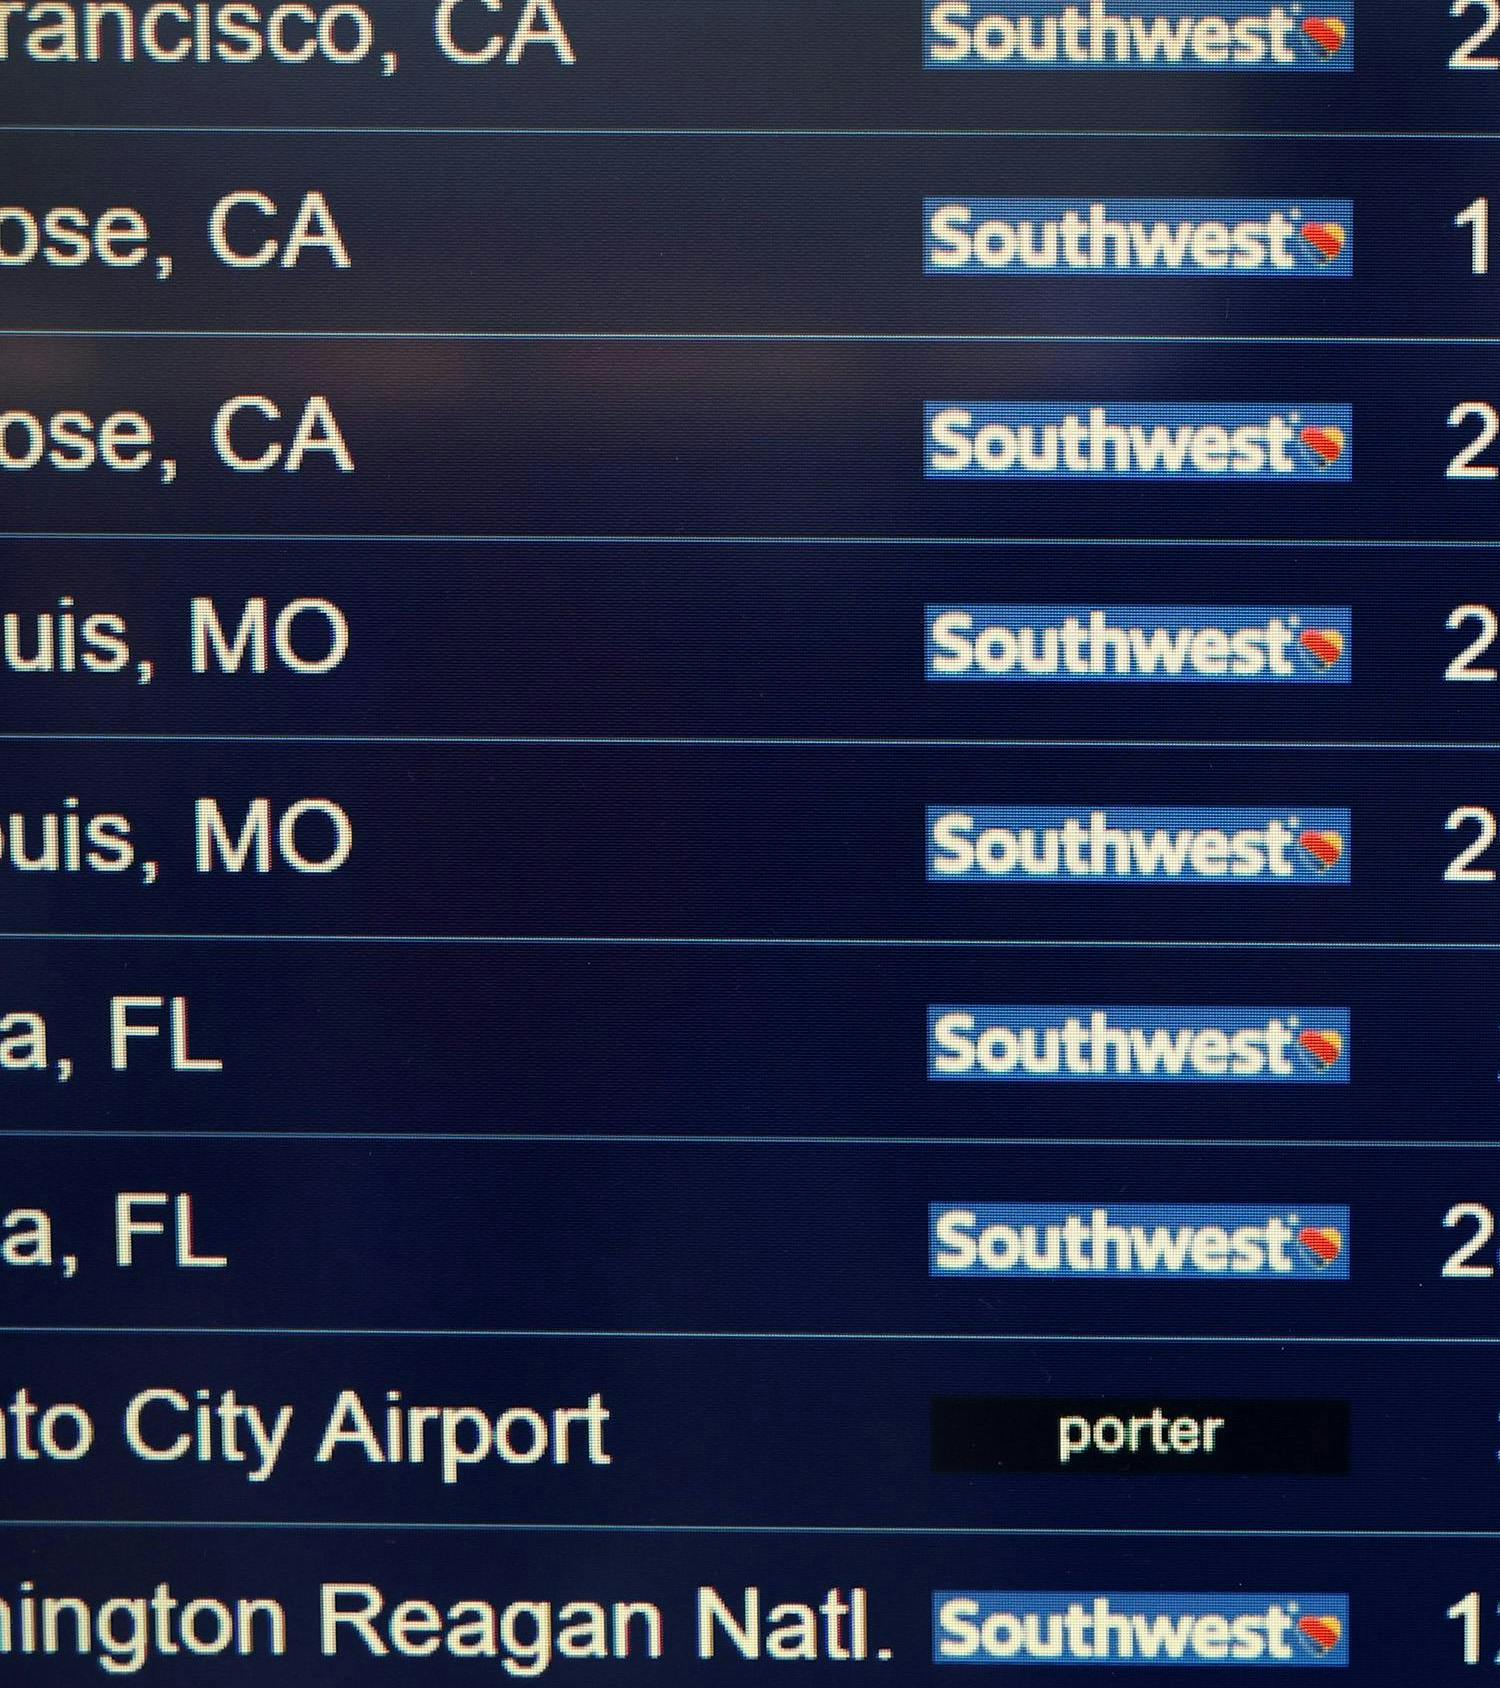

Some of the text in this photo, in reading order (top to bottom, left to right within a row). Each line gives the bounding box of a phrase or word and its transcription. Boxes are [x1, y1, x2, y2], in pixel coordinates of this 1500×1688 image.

[435, 0, 576, 64] CA
[930, 0, 1295, 63] Southwest
[210, 190, 351, 268] CA
[930, 202, 1297, 269] Southwest
[214, 394, 355, 471] CA
[930, 407, 1297, 473] Southwest
[193, 597, 349, 673] MO
[932, 610, 1297, 675] Southwest
[0, 797, 157, 883] uis,
[197, 798, 353, 873] MO
[933, 811, 1297, 876] Southwest
[112, 996, 223, 1070] FL
[934, 1011, 1297, 1075] Southwest
[117, 1193, 227, 1266] FL
[936, 1208, 1297, 1272] Southwest
[0, 1388, 93, 1459] to
[126, 1388, 293, 1481] City
[317, 1390, 611, 1483] Airport
[1059, 1409, 1224, 1461] porter
[0, 1581, 285, 1673] ington
[322, 1583, 662, 1677] Reagan
[699, 1586, 892, 1660] Natl.
[939, 1597, 1297, 1659] Southwest
